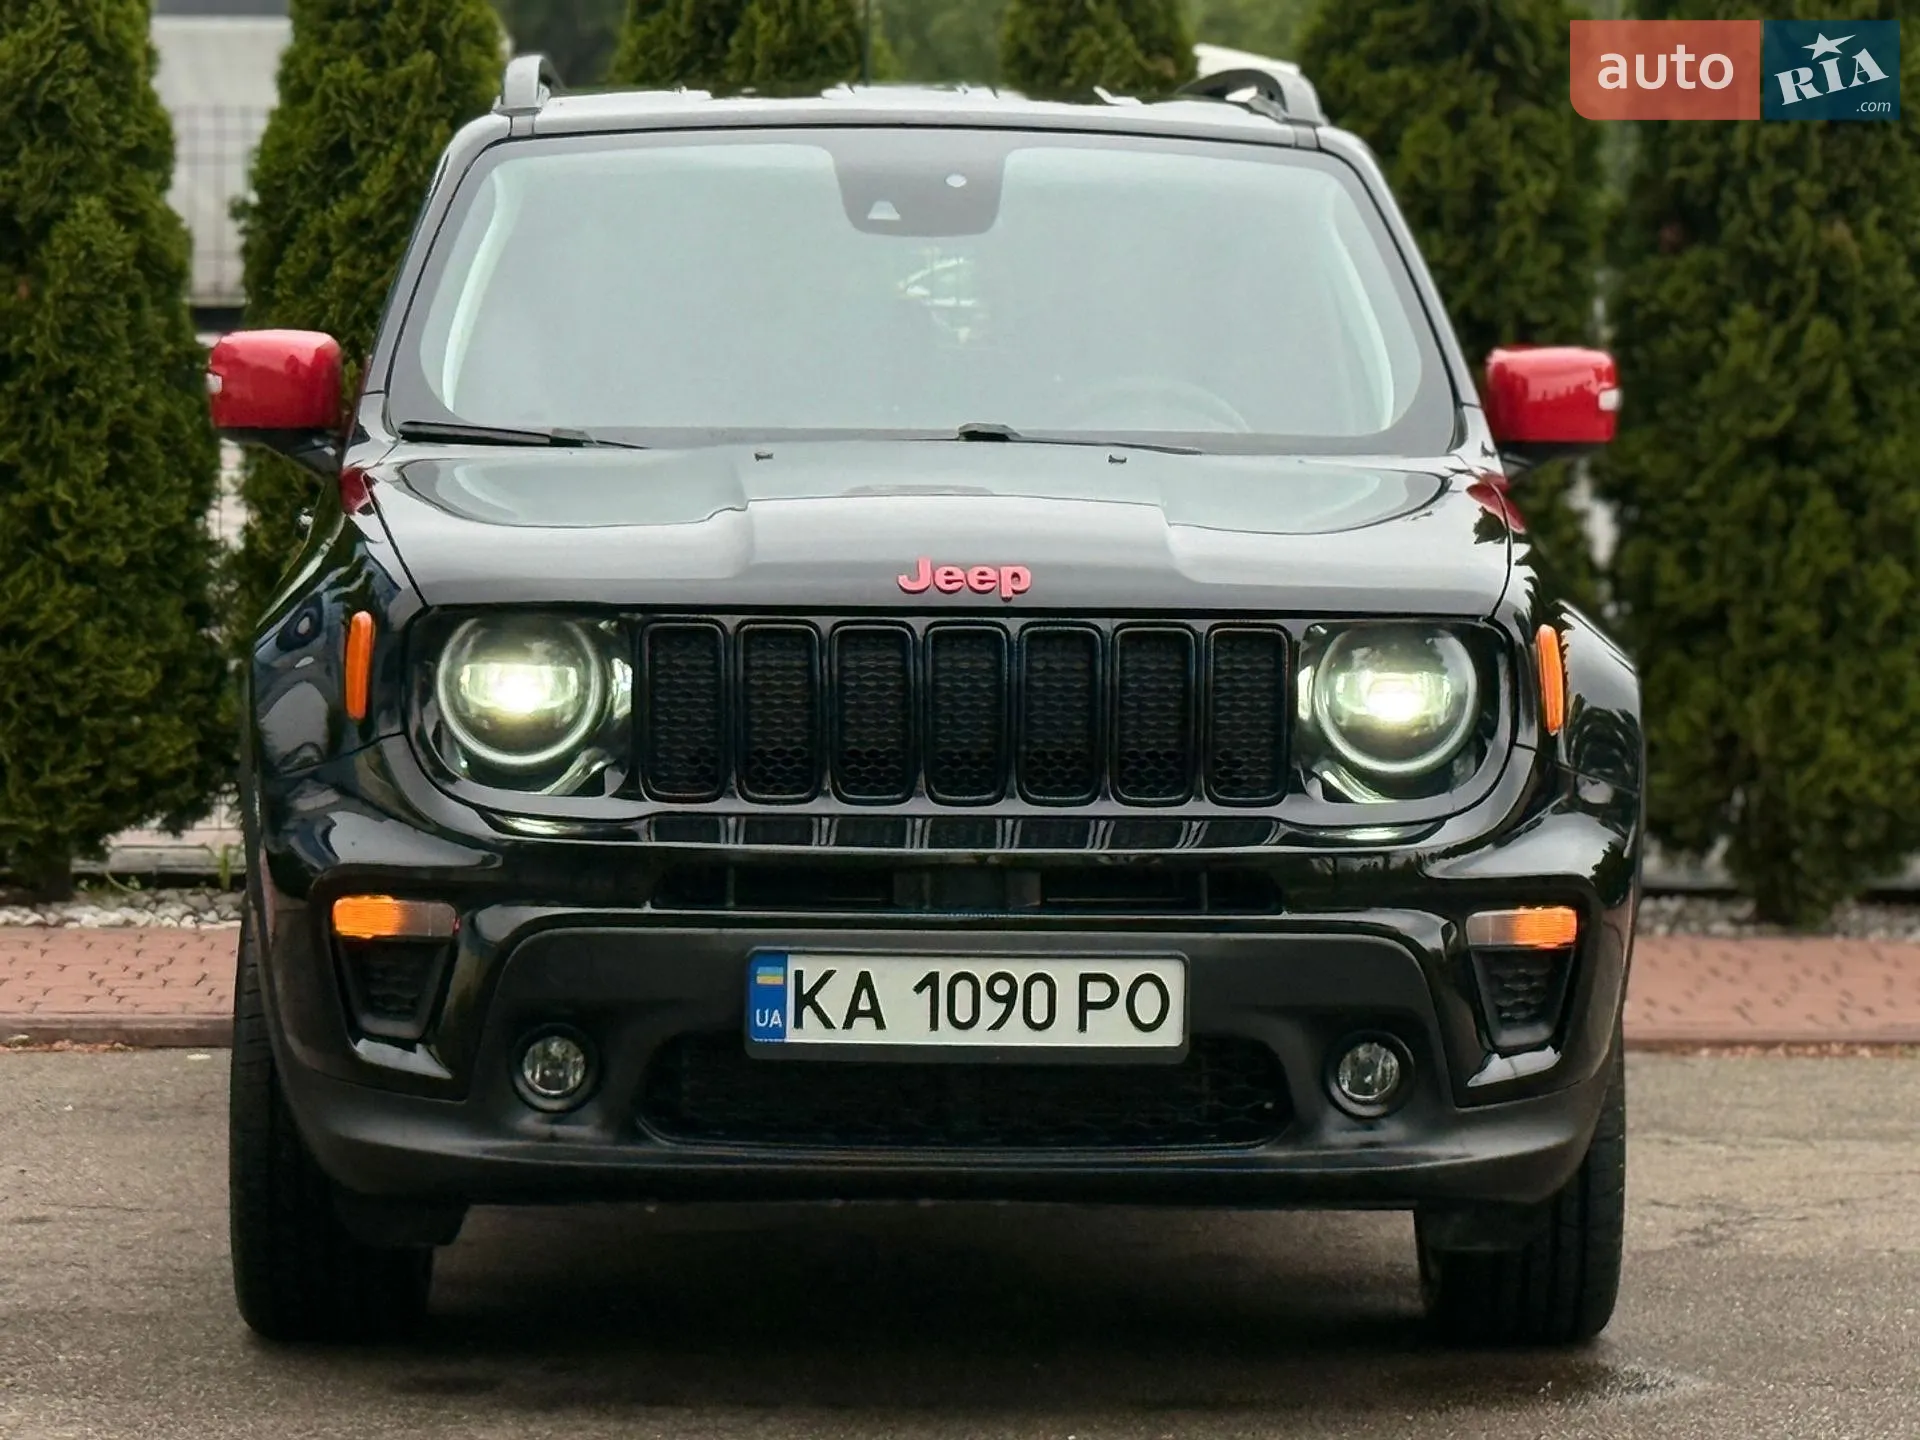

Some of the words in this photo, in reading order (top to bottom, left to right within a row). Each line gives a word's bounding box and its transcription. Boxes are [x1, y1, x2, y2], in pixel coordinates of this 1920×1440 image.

[897, 556, 1032, 602] Jeep
[755, 1009, 783, 1028] UA
[793, 968, 887, 1031] KA
[912, 970, 1057, 1032] 1090
[1077, 972, 1171, 1034] PO
